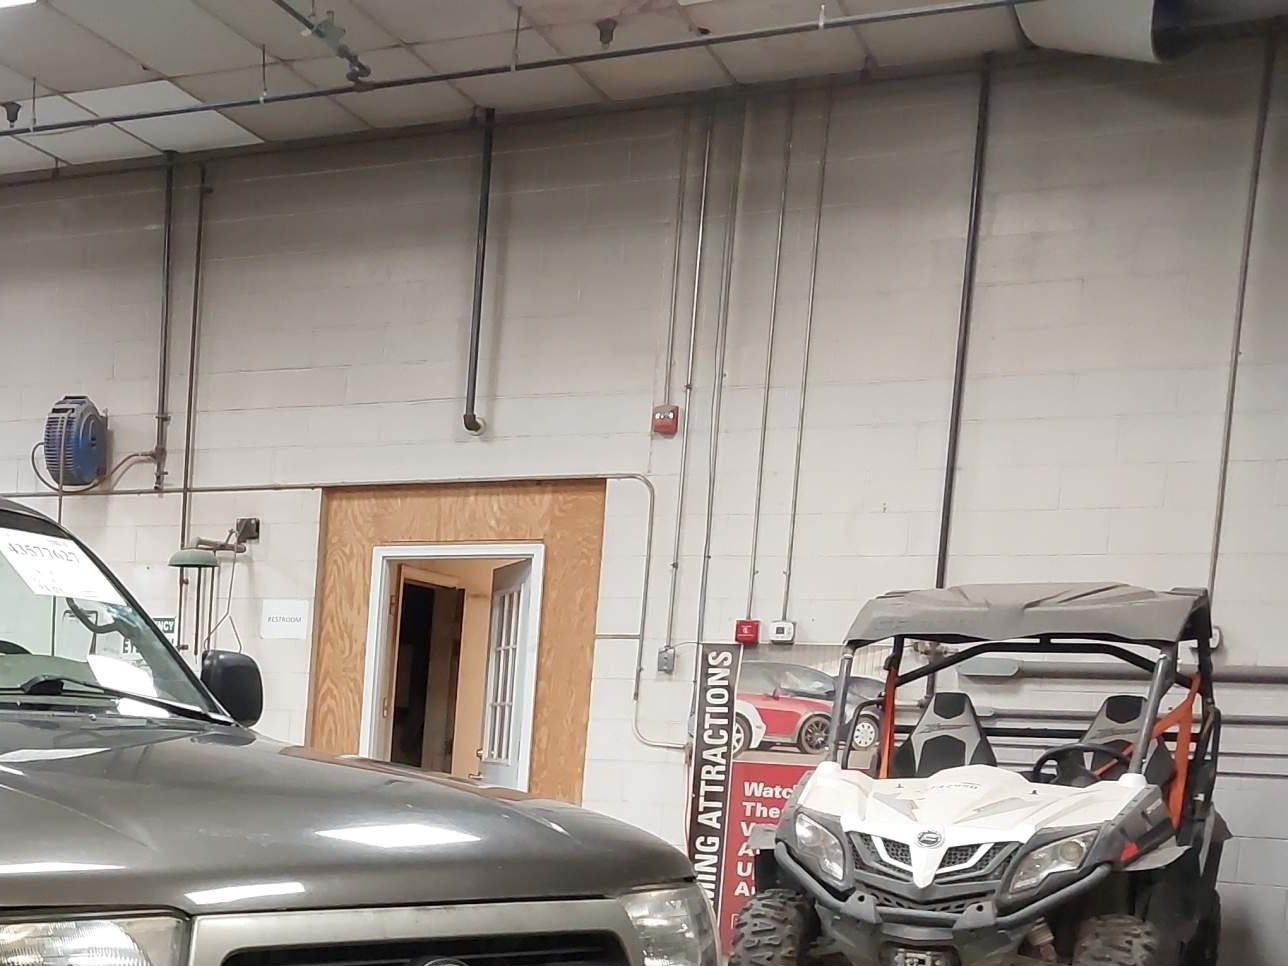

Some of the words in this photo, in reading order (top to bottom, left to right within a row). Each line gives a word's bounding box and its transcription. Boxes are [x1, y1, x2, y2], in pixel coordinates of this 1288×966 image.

[697, 651, 733, 830] ATTRACTIONS
[744, 781, 796, 798] Watc
[742, 801, 784, 818] The
